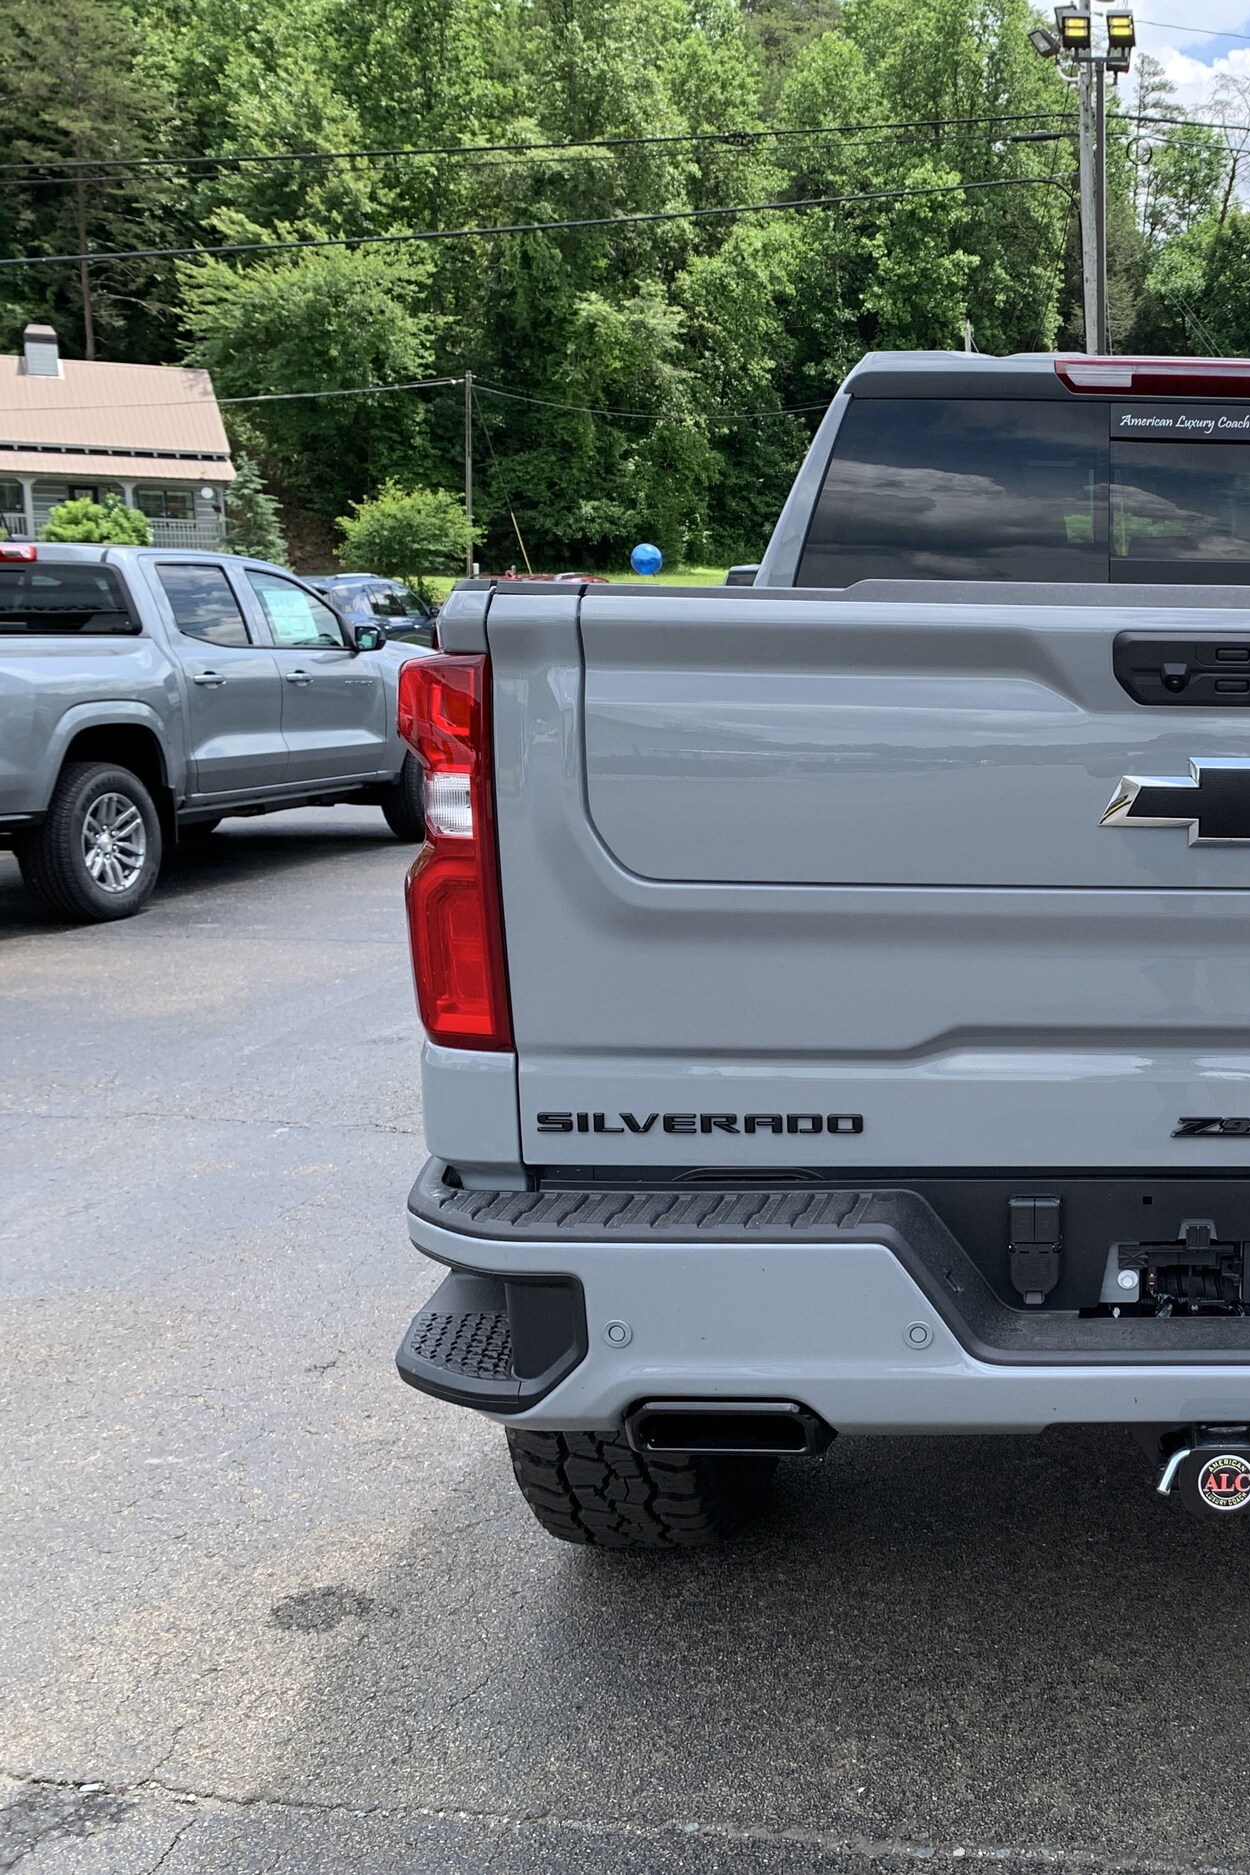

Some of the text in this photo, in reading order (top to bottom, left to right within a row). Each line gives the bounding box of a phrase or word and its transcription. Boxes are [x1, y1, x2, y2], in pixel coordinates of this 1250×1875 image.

[1119, 413, 1173, 427] American
[1175, 415, 1217, 434] Luxury
[537, 1111, 864, 1134] SILVERADO
[1208, 1459, 1246, 1472] AMERICAN
[1203, 1473, 1250, 1492] ALC
[1206, 1492, 1247, 1505] LUXURY COACH
